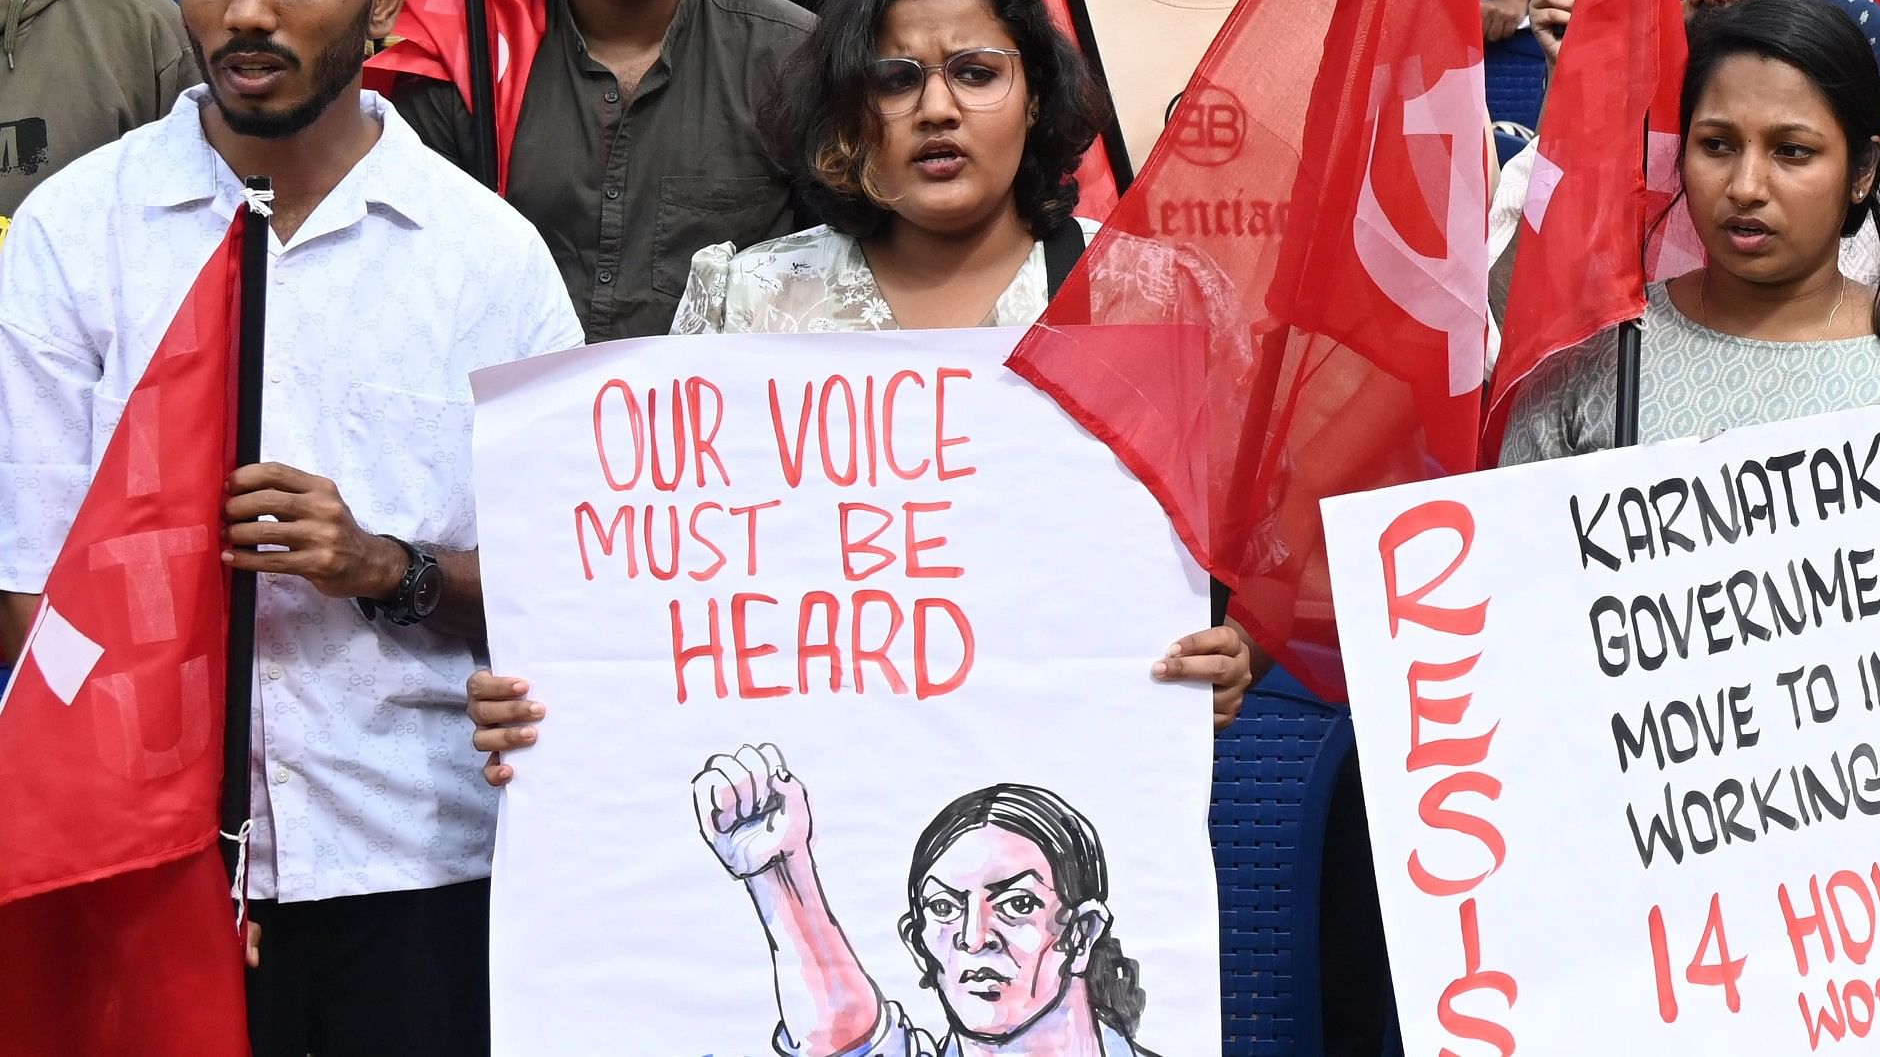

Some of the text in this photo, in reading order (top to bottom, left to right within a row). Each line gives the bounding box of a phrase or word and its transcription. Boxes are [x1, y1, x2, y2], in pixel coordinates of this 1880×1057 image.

[593, 367, 977, 492] OUR VOICE
[574, 498, 965, 582] MUST BE
[670, 590, 977, 705] HEARD
[1610, 682, 1761, 777] MOVE
[1776, 663, 1840, 731] TO
[1647, 889, 1749, 1024] 14
